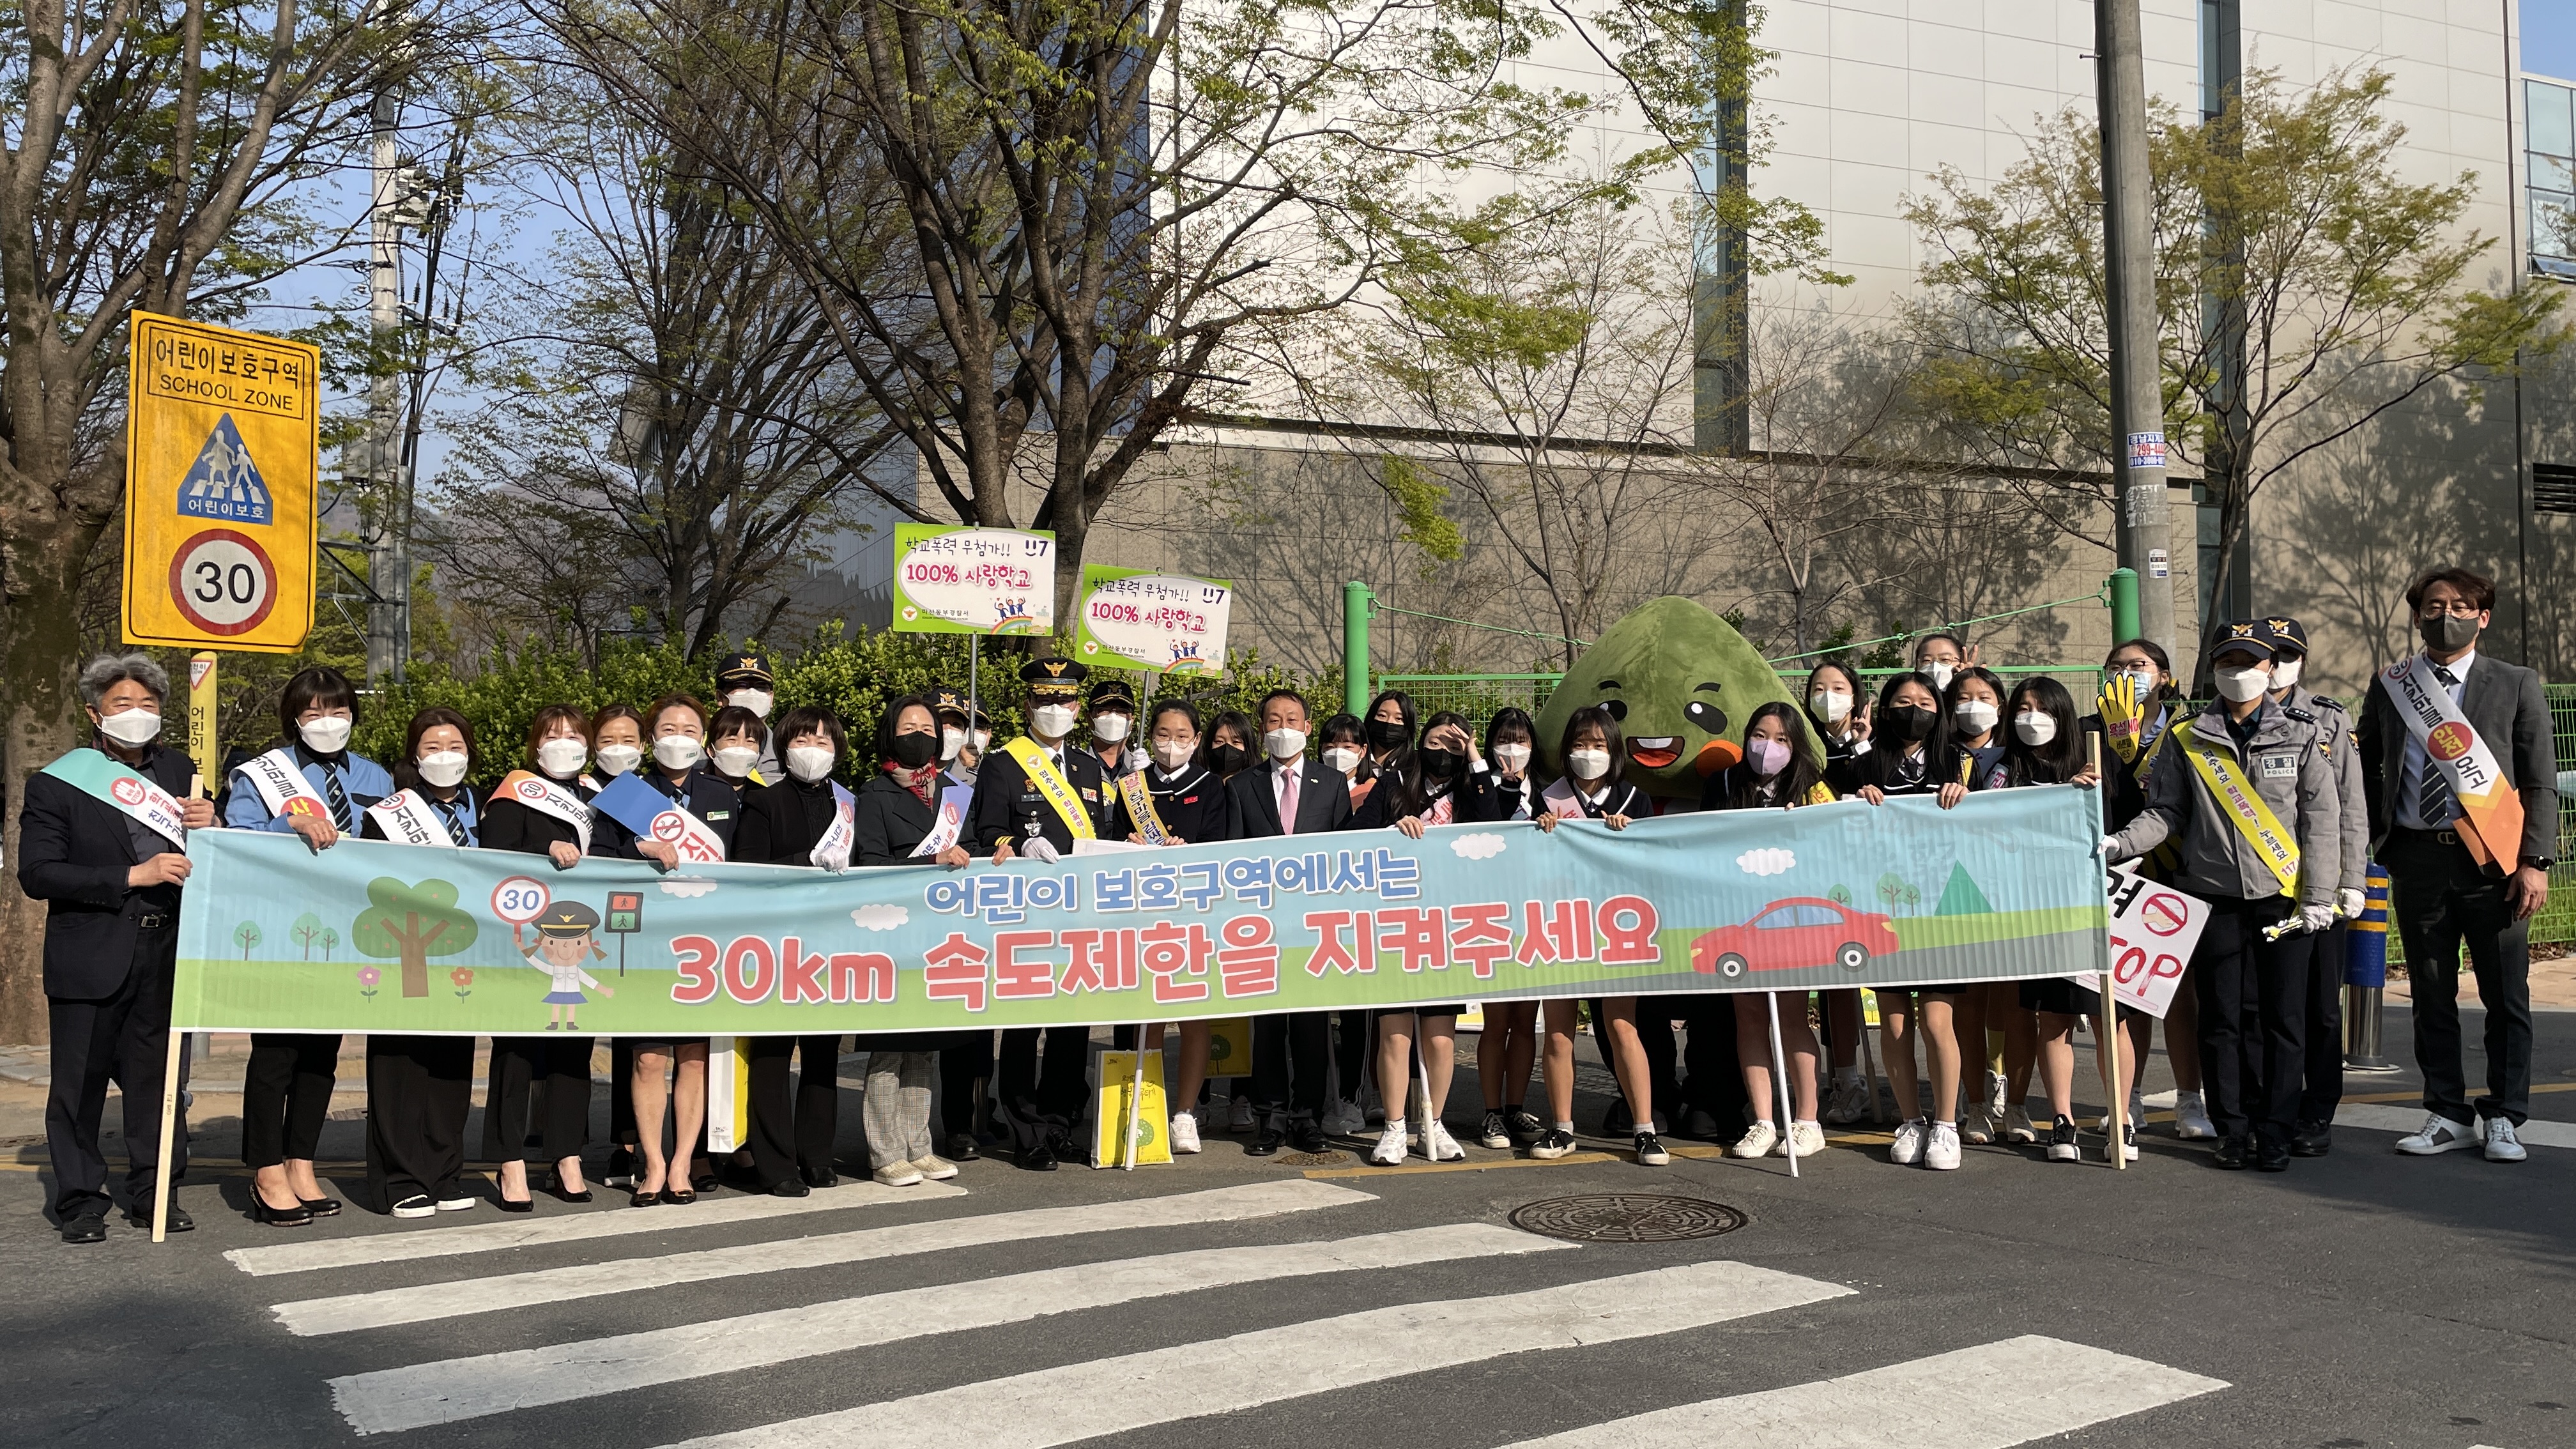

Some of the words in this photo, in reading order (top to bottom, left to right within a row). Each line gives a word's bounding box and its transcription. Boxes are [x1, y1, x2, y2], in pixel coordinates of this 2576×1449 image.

[156, 338, 300, 390] 어린이보호구역
[160, 374, 236, 401] SCHOOL
[245, 388, 293, 411] ZONE
[188, 498, 264, 519] 어린이보호
[905, 537, 956, 555] 학교폭력
[962, 539, 1010, 557] 무첨가!!
[194, 561, 255, 604] 30
[907, 564, 958, 583] 100%
[965, 564, 1031, 588] 사랑학교
[1092, 578, 1140, 597] 학교폭력
[1145, 583, 1189, 602] 무첨가!!
[1092, 602, 1138, 623] 100%
[1145, 607, 1205, 632] 사랑학교
[2392, 660, 2408, 675] 30
[191, 707, 204, 750] 어린이
[2398, 673, 2444, 729] 지킨만큼
[2434, 724, 2466, 758] 안전
[2455, 756, 2488, 789] 오고
[524, 783, 542, 796] 30
[1038, 769, 1066, 799] 멈추세요
[381, 796, 401, 806] 30
[2203, 749, 2230, 785] 멈추세요
[2259, 829, 2288, 861] 누르세요
[503, 889, 539, 910] 30
[926, 873, 1077, 923] 어린이
[1095, 847, 1420, 912] 보호구역에서는
[670, 933, 896, 1003] 30km
[924, 914, 1278, 1011] 속도제한을
[1304, 895, 1660, 977] 지켜주세요
